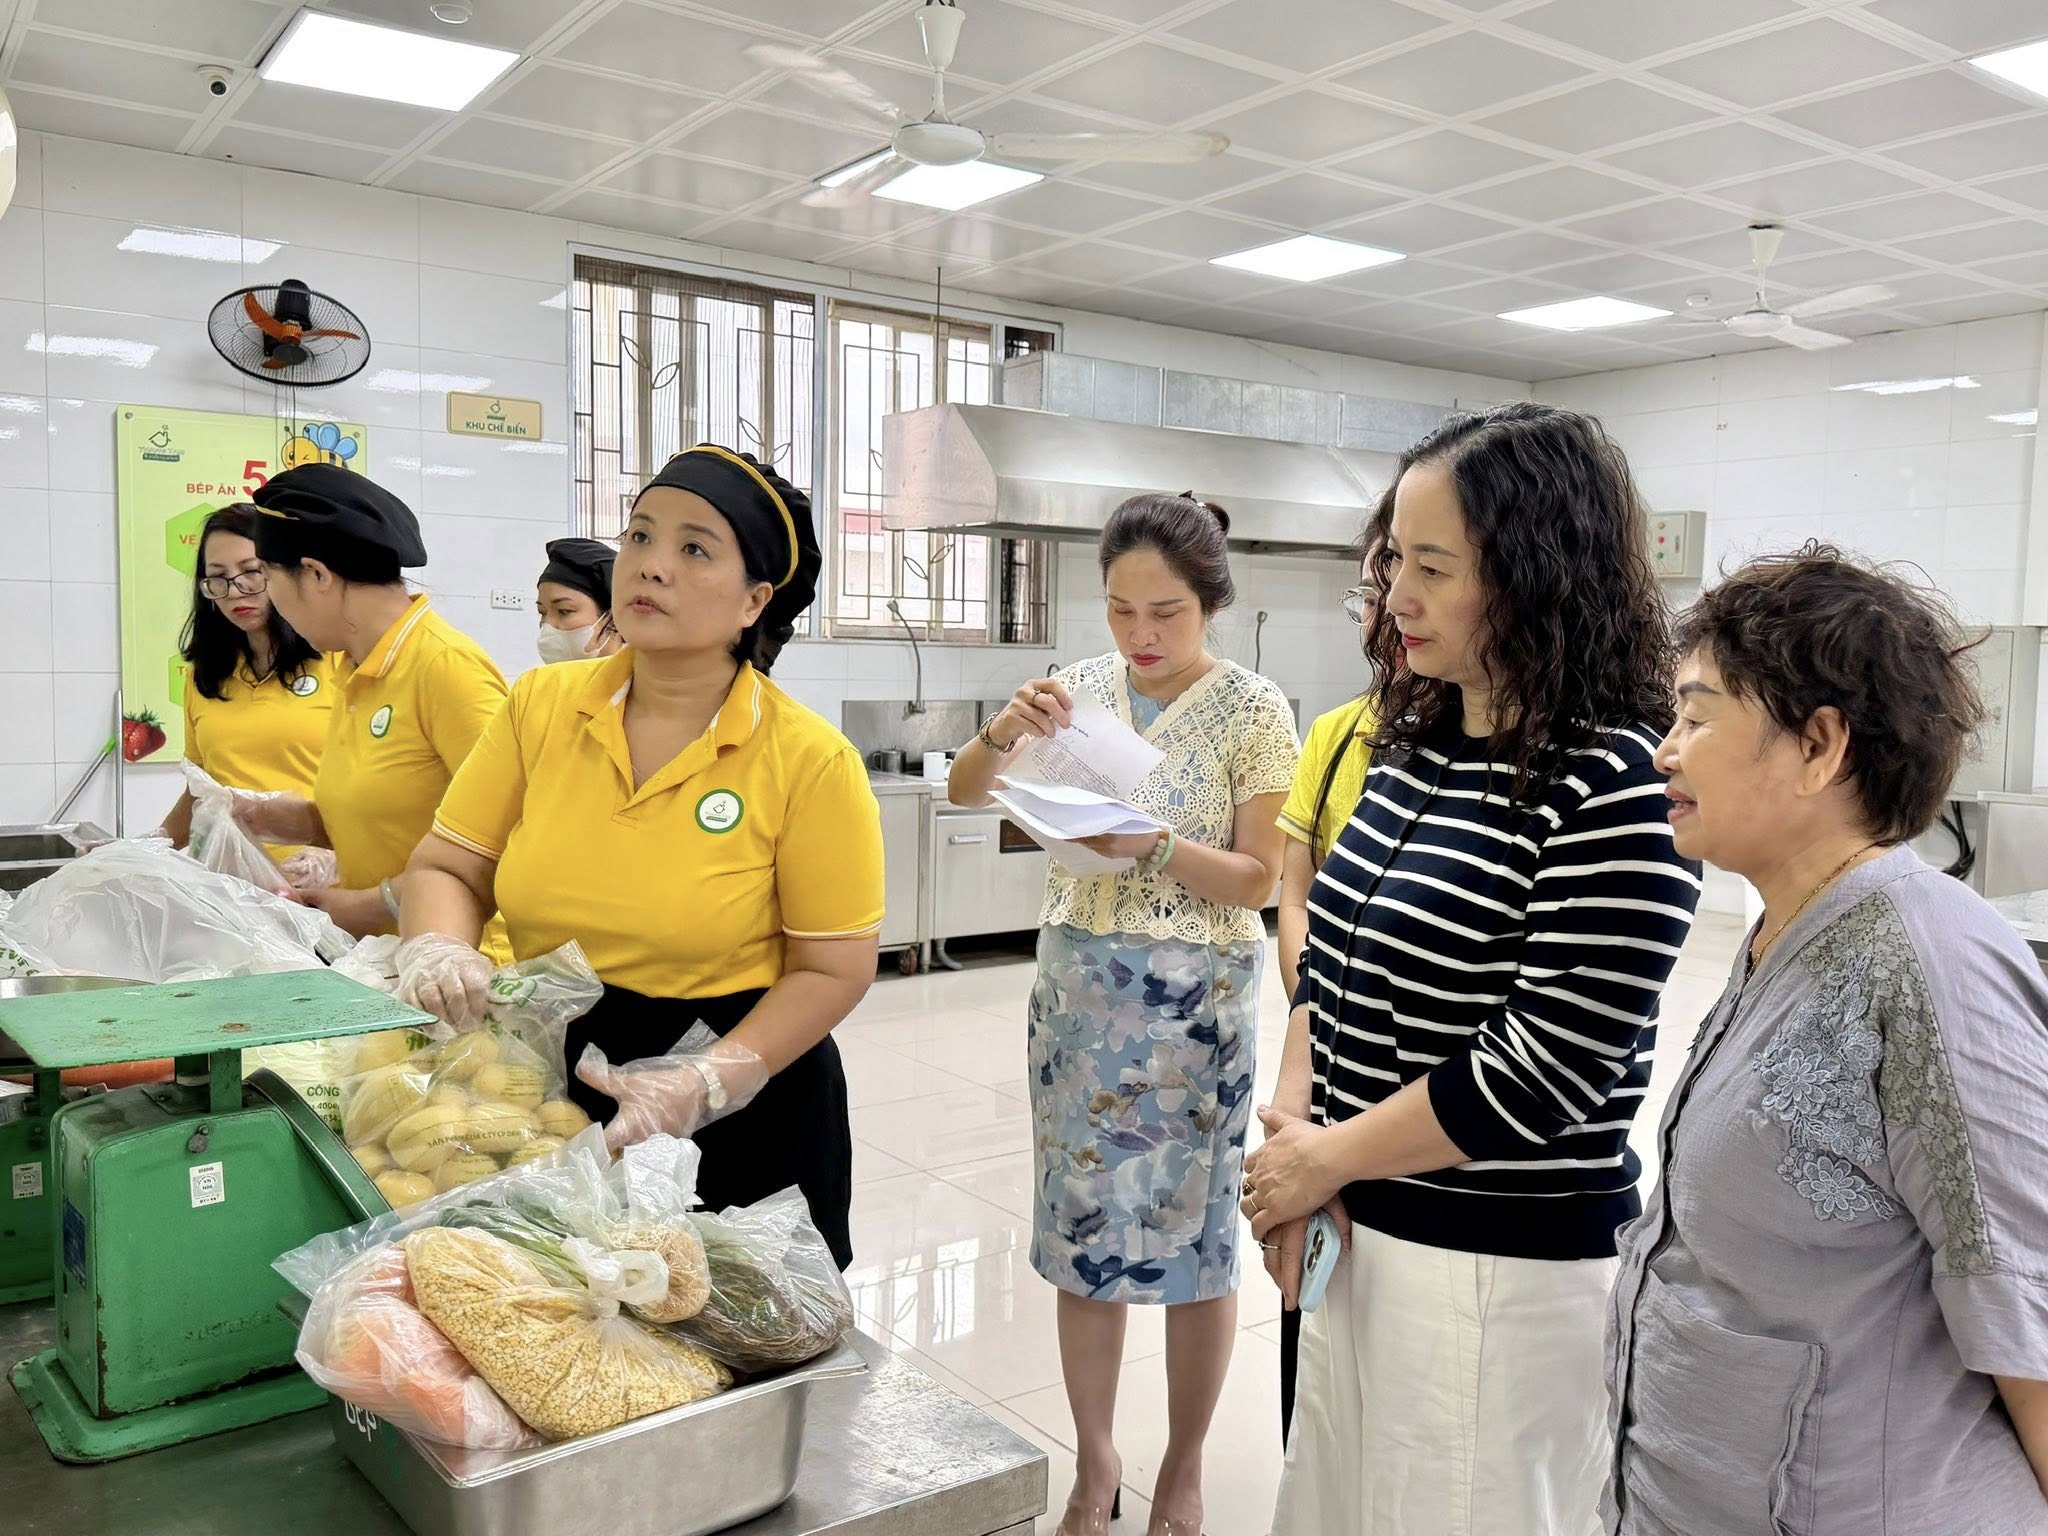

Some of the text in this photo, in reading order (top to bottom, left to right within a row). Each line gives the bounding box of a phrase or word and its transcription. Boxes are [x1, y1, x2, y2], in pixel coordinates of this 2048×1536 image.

[466, 421, 485, 431] KHU
[507, 422, 526, 435] BIẾN
[242, 460, 268, 498] 5
[306, 1084, 341, 1097] CÔNG
